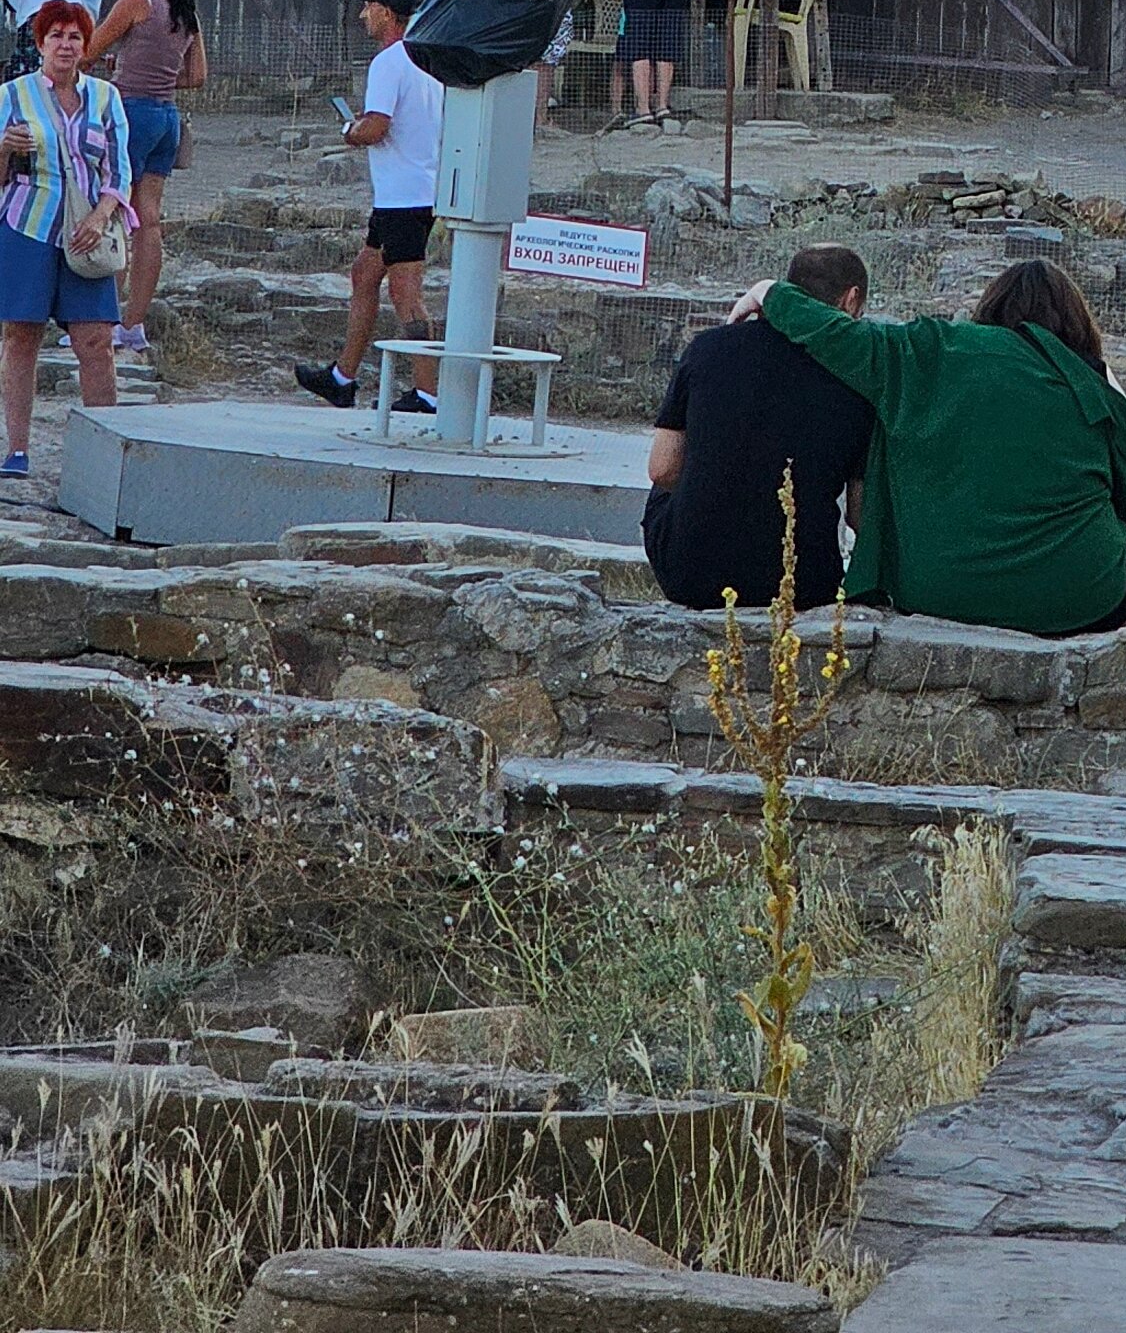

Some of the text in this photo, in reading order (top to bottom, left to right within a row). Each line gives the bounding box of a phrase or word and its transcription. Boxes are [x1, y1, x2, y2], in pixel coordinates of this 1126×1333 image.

[515, 234, 640, 257] АРХЕОЛОГИЧЕСКИЕ РАСКОПКИ
[559, 229, 598, 242] ВЕДУТСЯ
[514, 246, 640, 274] ВХОД ЗАПРЕЩЕН!
